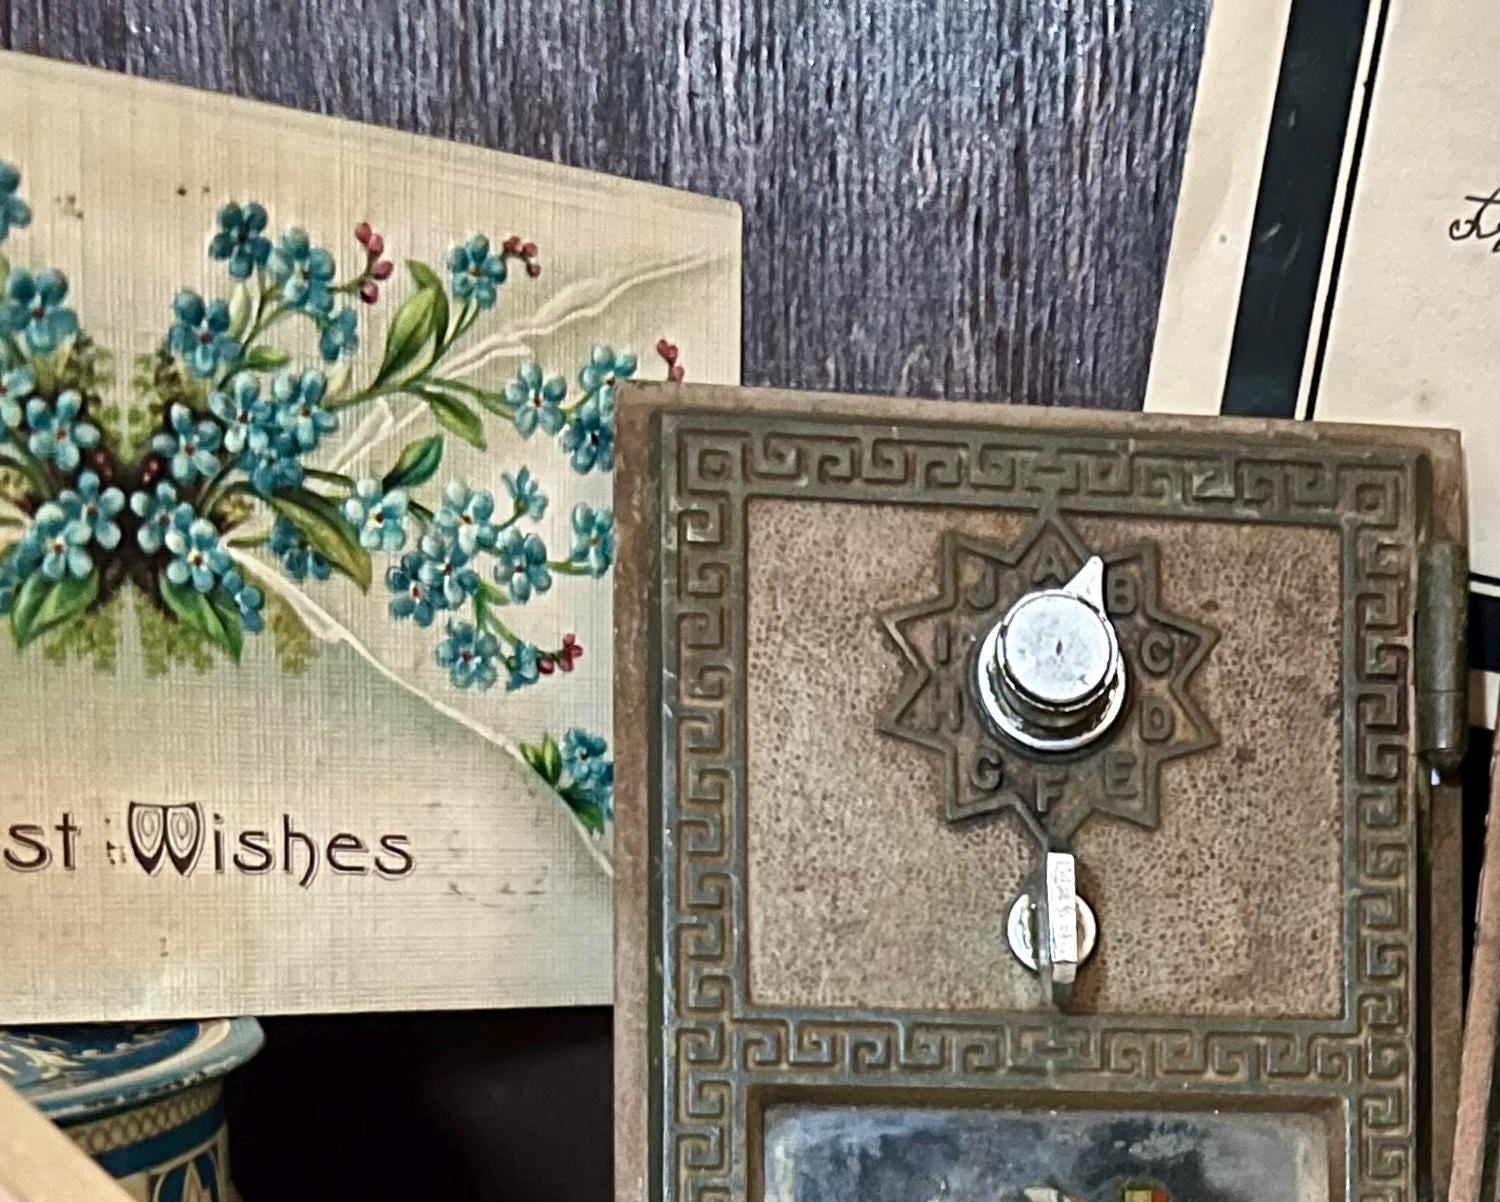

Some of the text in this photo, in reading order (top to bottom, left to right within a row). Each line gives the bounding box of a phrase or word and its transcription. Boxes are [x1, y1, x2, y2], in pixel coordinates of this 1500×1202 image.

[1032, 541, 1072, 584] A
[965, 563, 998, 610] J
[1107, 565, 1138, 616] B
[1139, 627, 1176, 676] C
[1140, 695, 1176, 742] D
[971, 750, 1003, 791] G
[1033, 770, 1066, 814] F
[1102, 751, 1138, 799] E
[126, 800, 417, 889] Wishes
